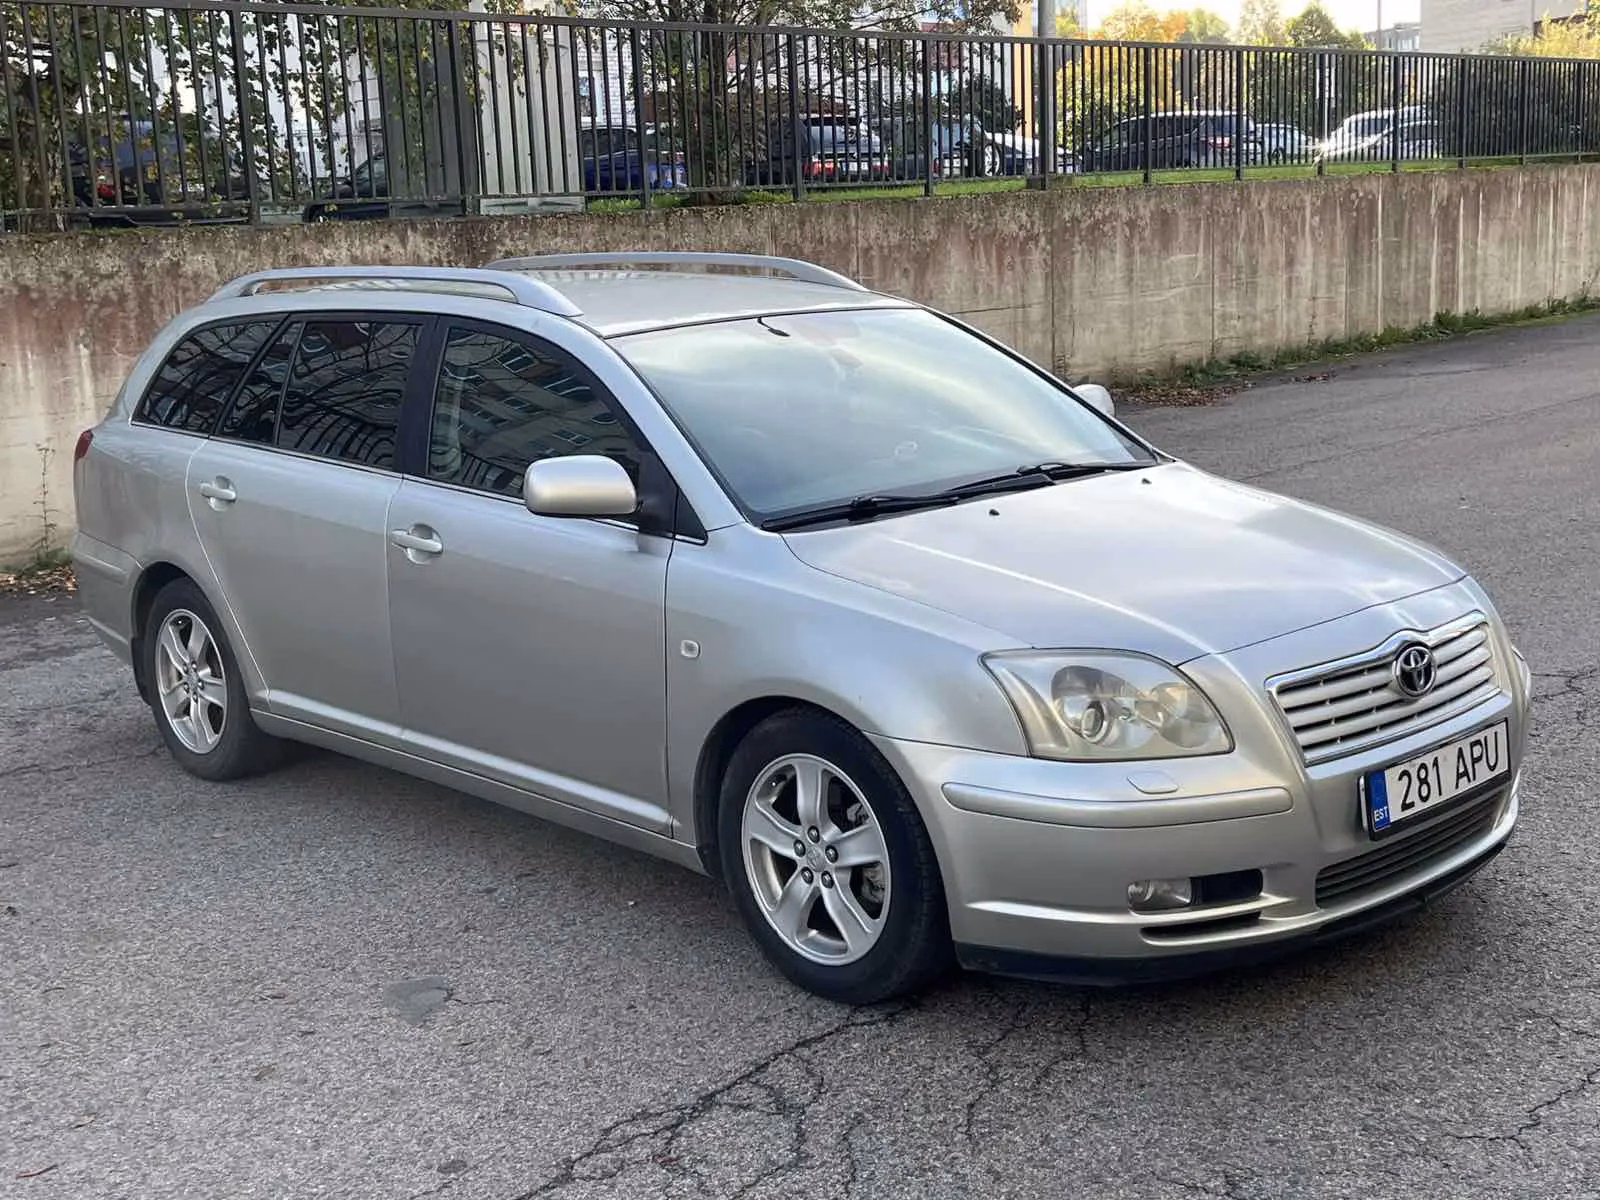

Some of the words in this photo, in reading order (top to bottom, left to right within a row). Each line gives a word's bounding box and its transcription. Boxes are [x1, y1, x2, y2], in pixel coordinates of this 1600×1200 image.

[1398, 756, 1442, 812] 281
[1455, 731, 1498, 789] APU
[1373, 806, 1389, 821] EST
